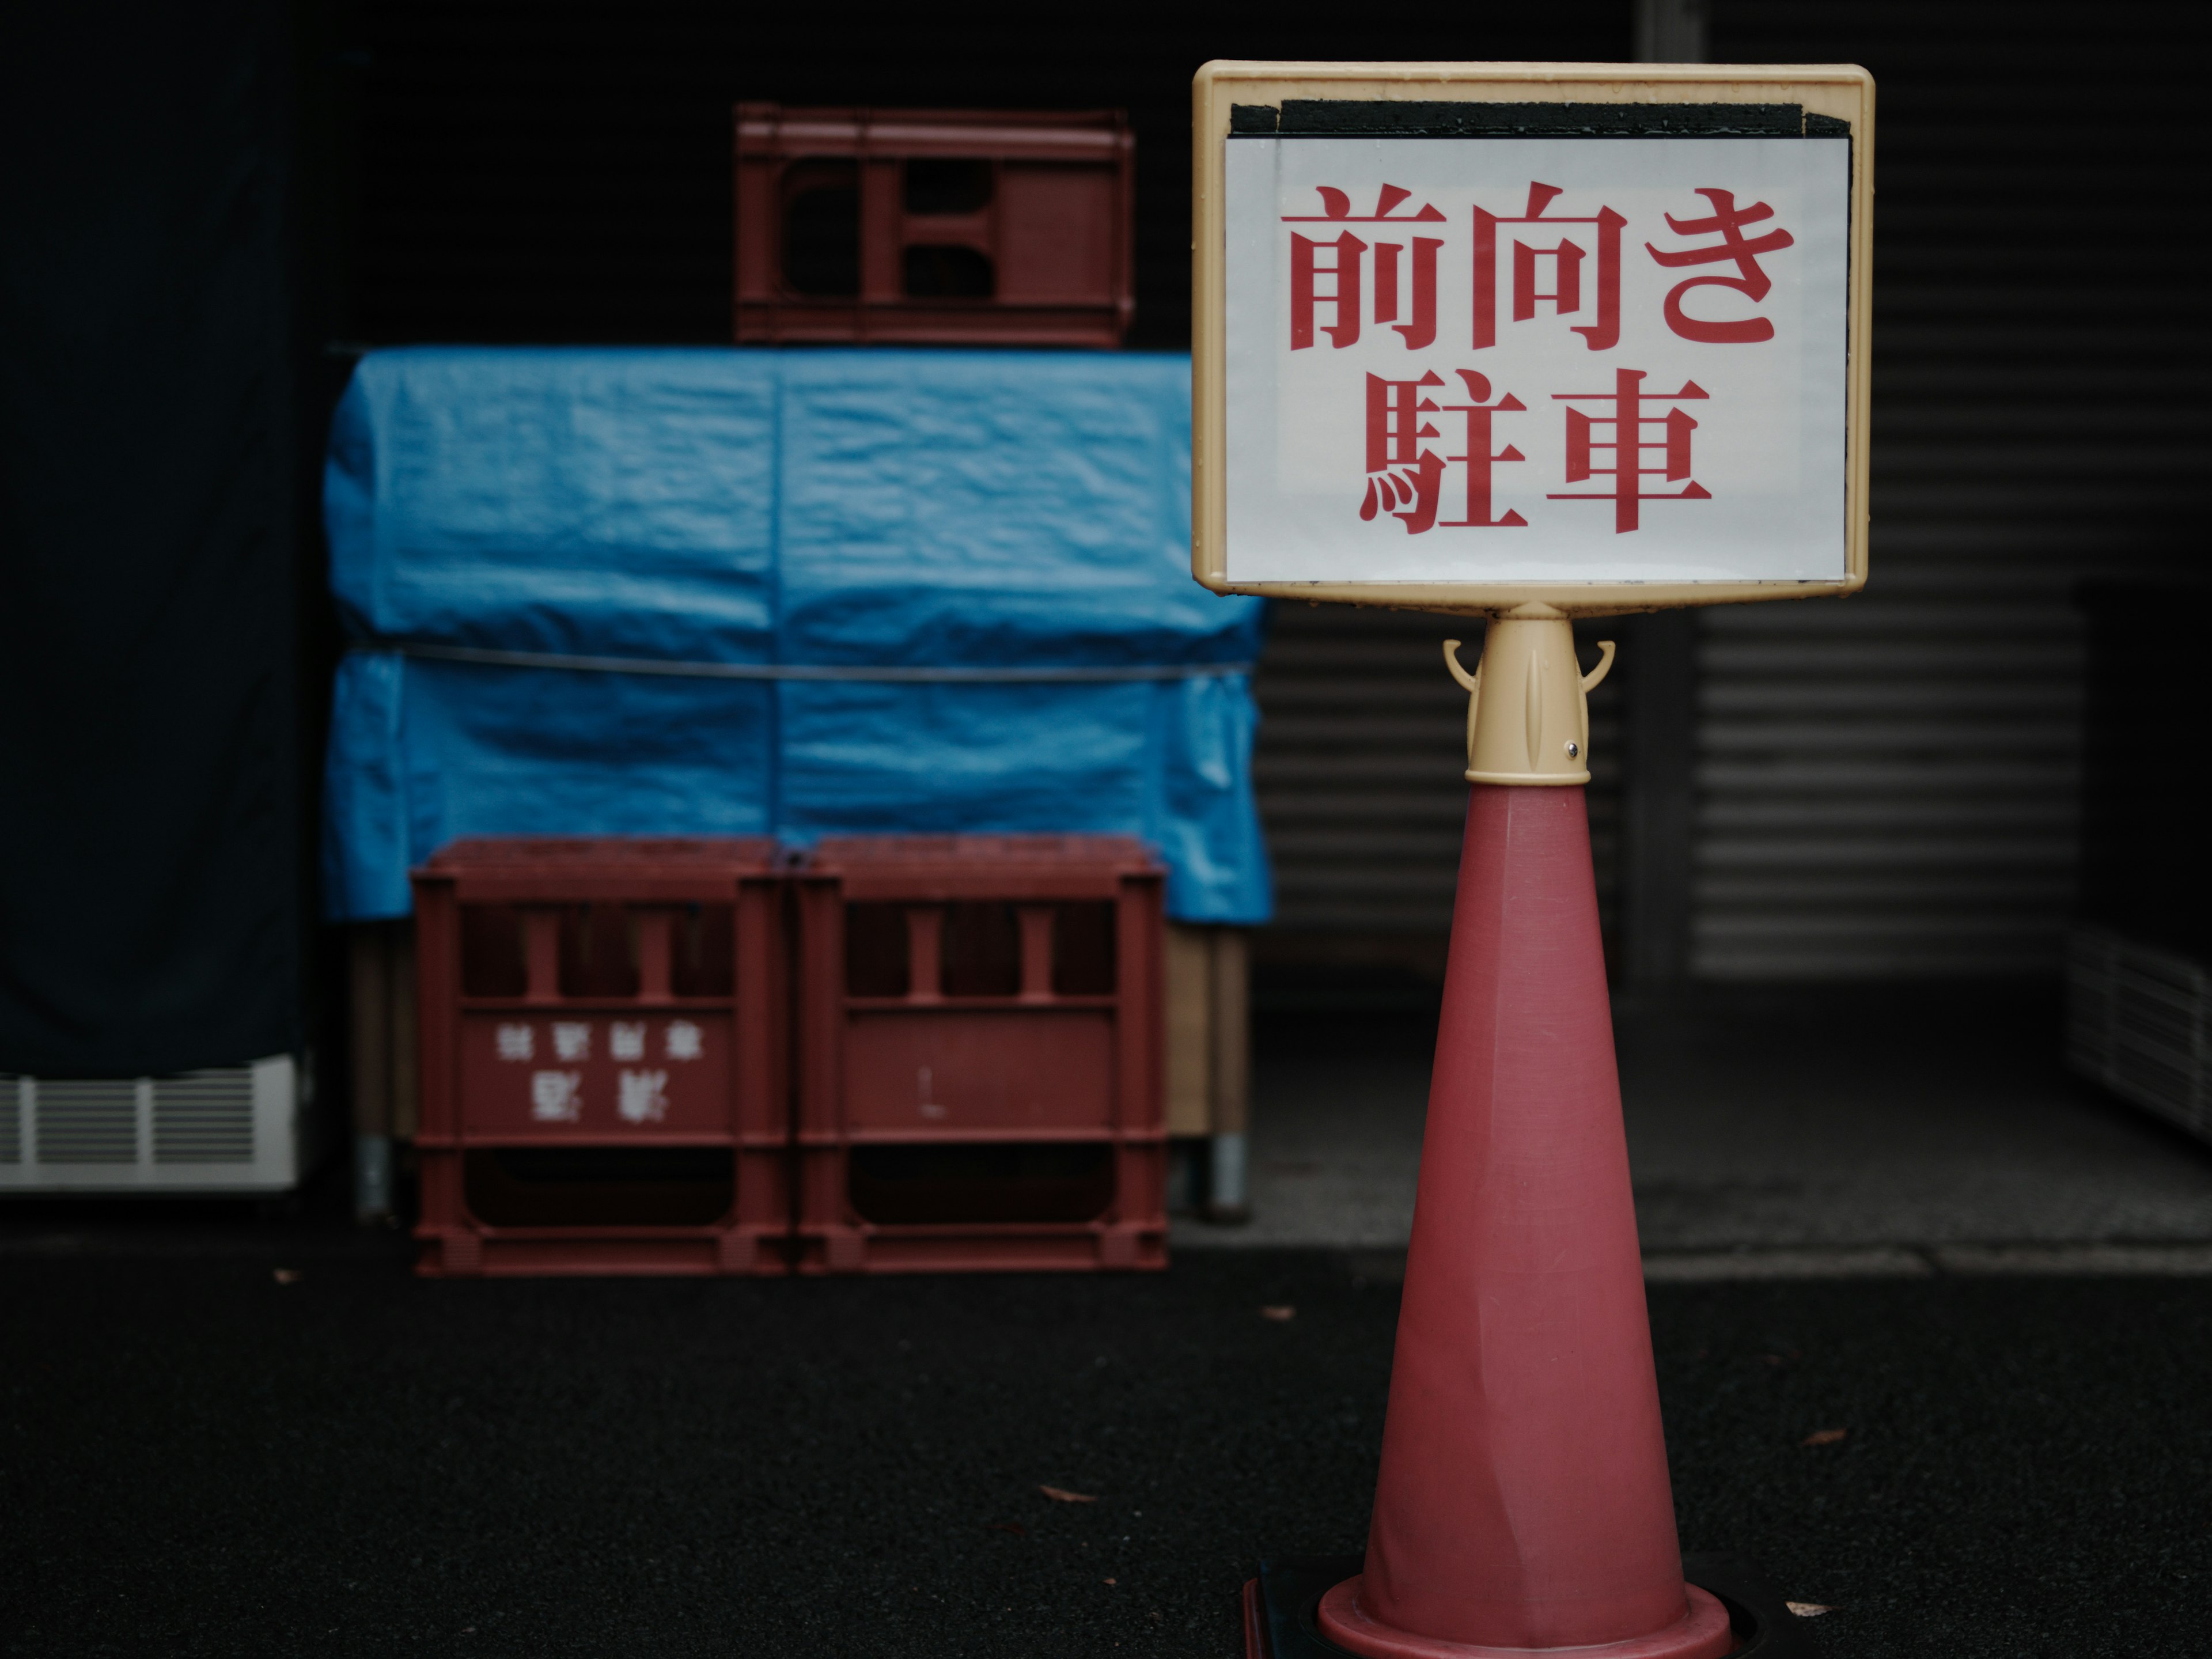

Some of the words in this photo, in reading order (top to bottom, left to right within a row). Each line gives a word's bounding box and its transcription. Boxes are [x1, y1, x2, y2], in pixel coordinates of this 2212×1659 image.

[1281, 181, 1794, 350] 前向き
[1360, 369, 1711, 535] 駐車
